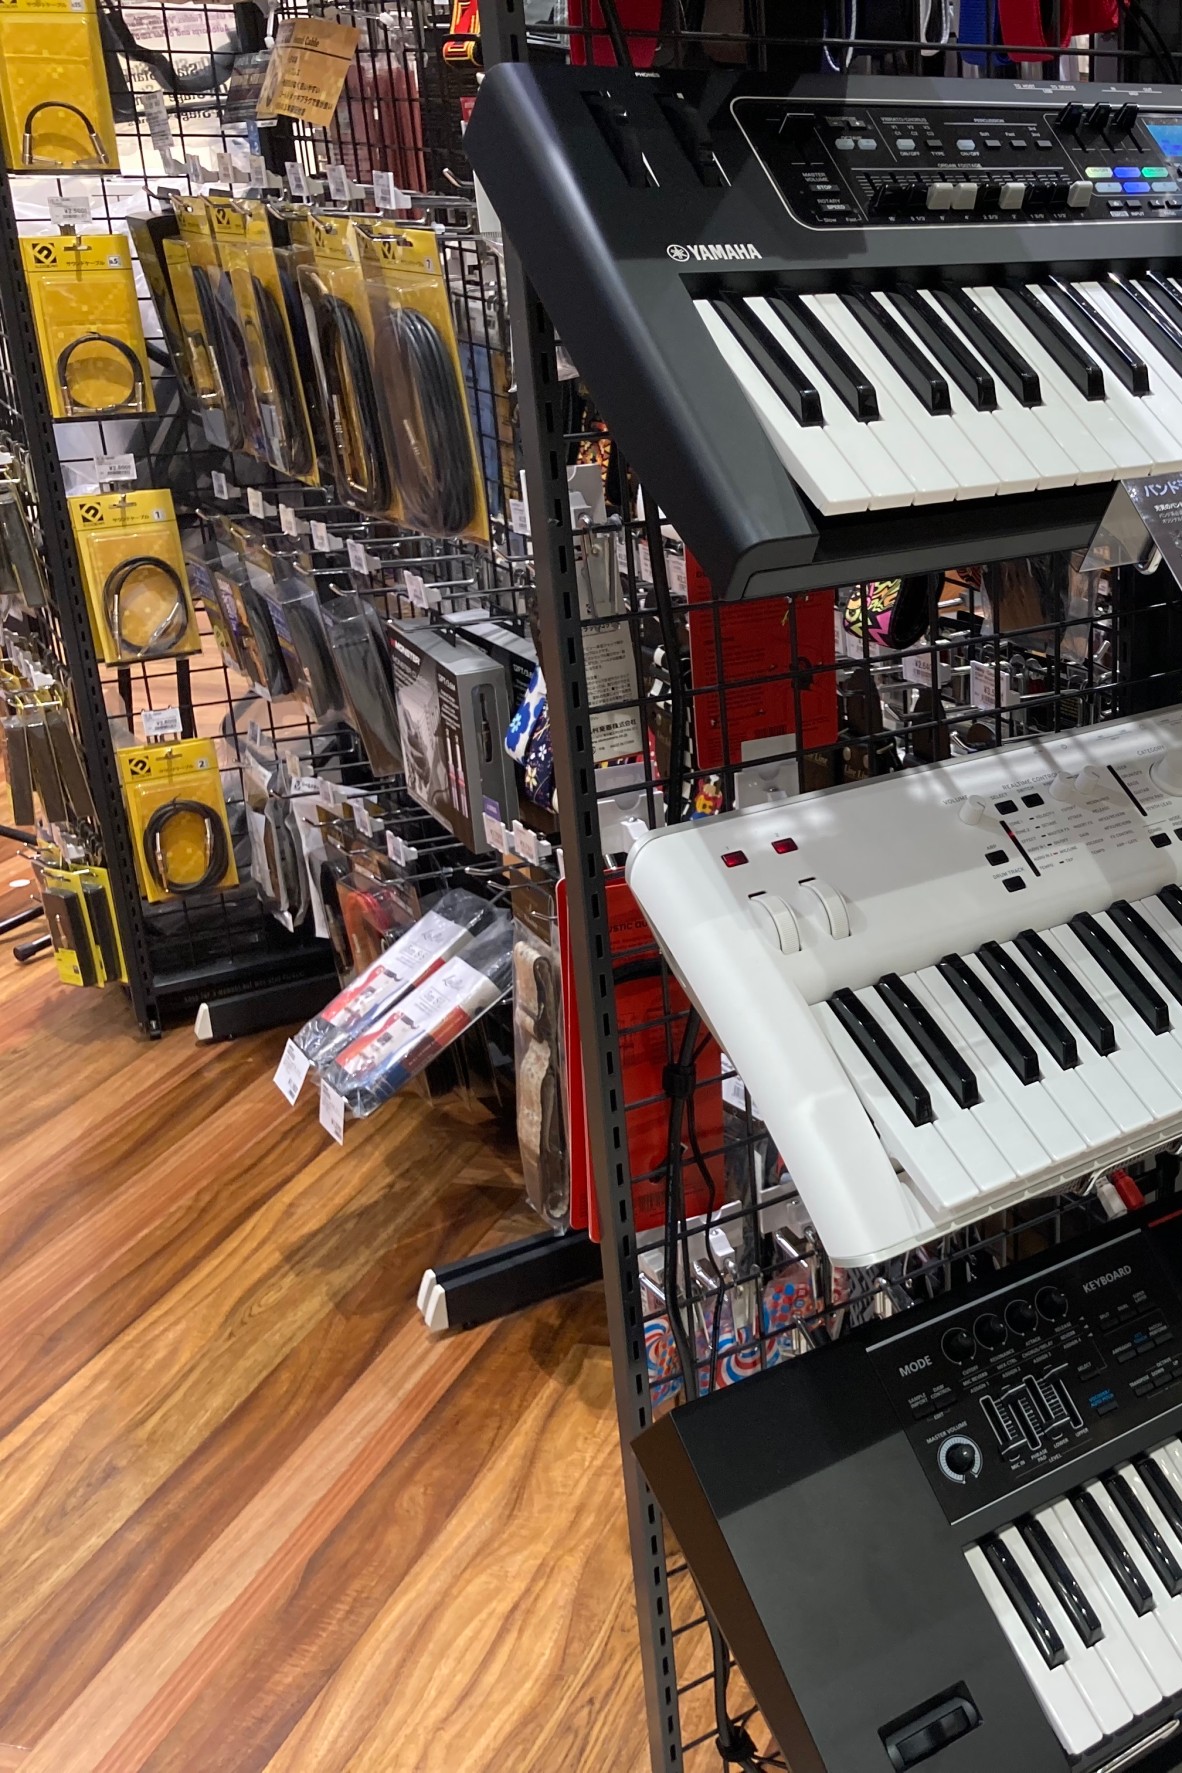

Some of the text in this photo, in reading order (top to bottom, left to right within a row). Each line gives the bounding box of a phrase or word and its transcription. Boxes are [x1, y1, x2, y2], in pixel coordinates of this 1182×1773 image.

[687, 243, 763, 260] YAMAHA
[394, 640, 421, 666] MONSTER
[1082, 1265, 1132, 1294] KEYBOARD
[899, 1355, 933, 1377] MODE
[926, 1421, 968, 1444] MASTER VOLUME
